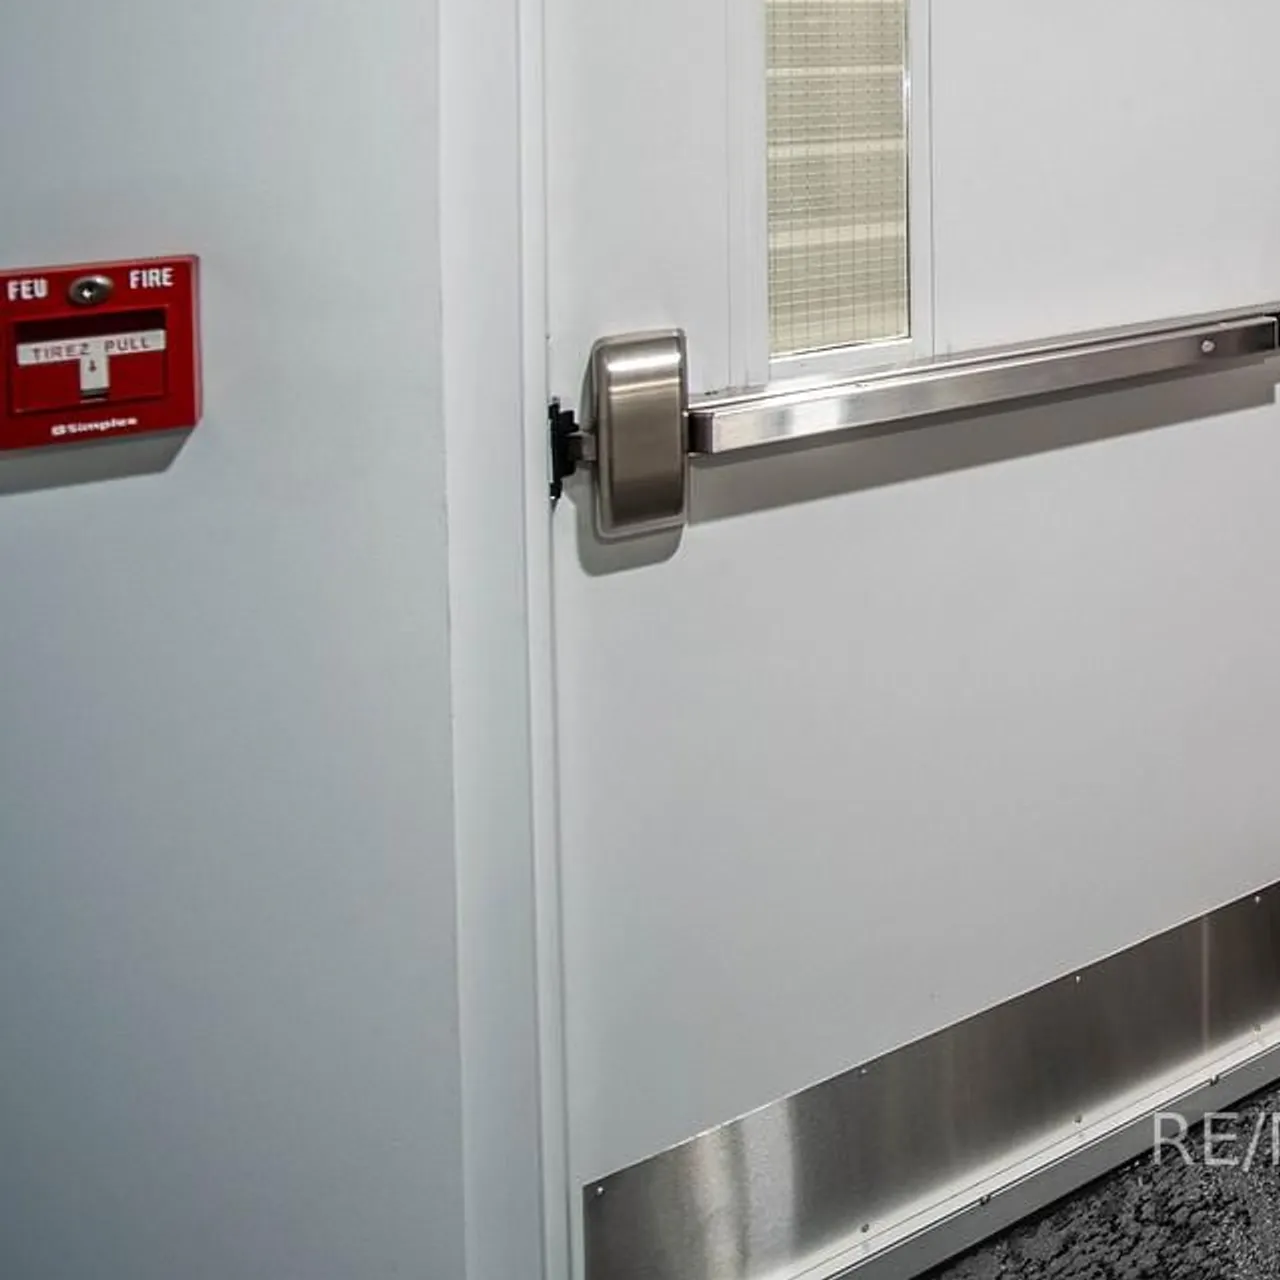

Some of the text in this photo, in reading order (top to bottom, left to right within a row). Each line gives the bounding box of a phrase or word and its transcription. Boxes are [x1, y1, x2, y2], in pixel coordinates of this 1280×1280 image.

[7, 268, 174, 301] FEU FIRE
[31, 336, 151, 361] TIREZ PULL
